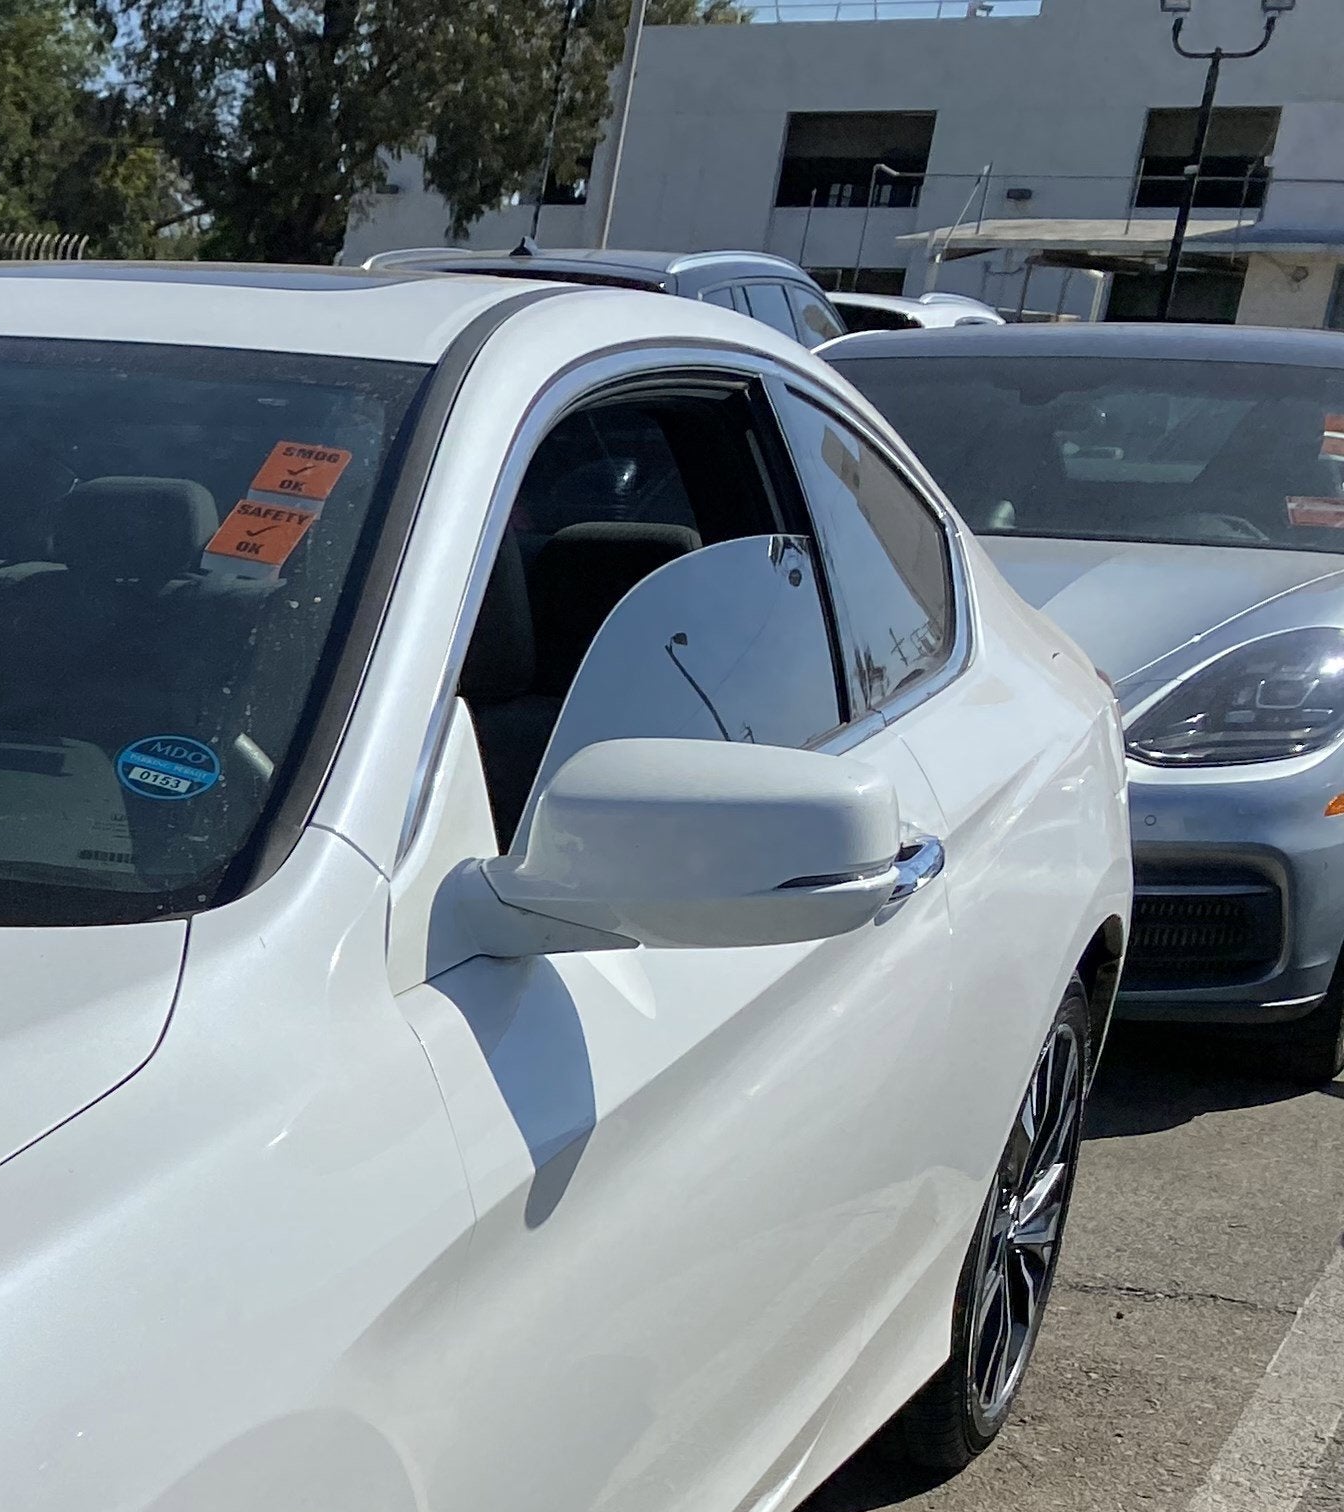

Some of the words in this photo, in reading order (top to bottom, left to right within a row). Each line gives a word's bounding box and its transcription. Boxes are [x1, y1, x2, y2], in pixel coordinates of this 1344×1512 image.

[283, 446, 340, 464] SMOG
[279, 479, 306, 492] OK
[237, 504, 310, 525] SAFETY
[236, 541, 264, 555] OK
[150, 741, 209, 764] MDO
[139, 770, 180, 789] 0153
